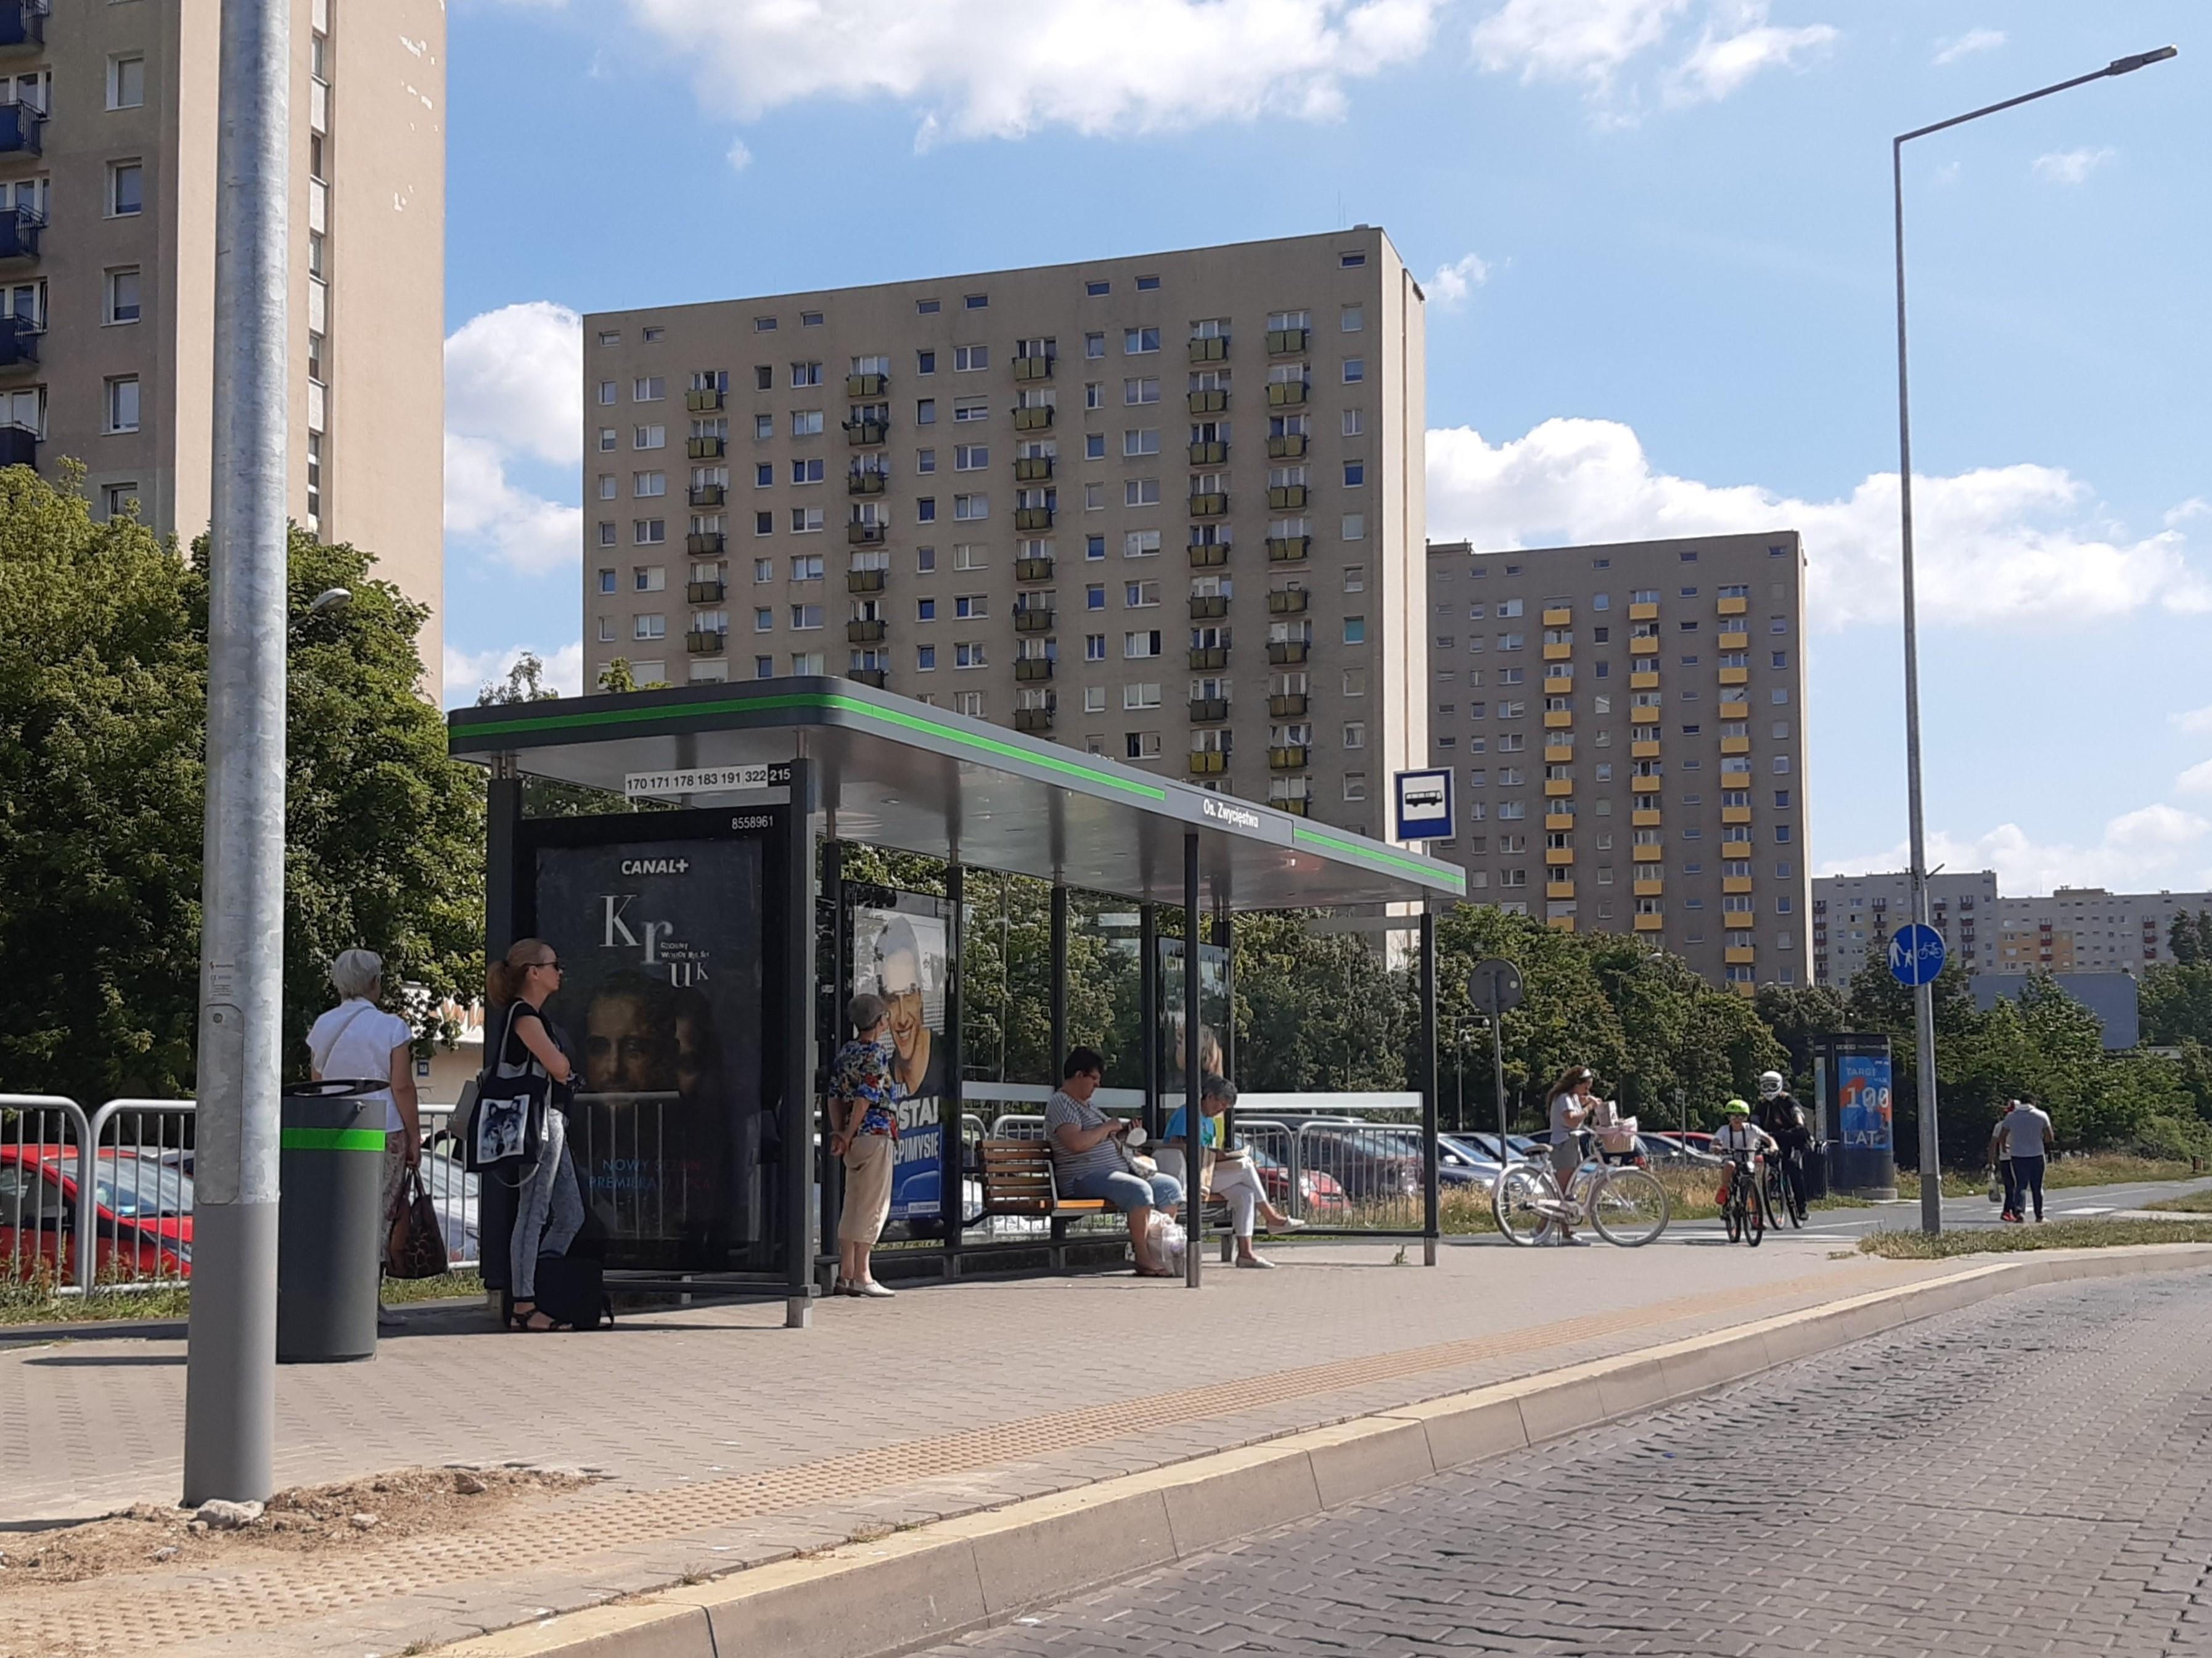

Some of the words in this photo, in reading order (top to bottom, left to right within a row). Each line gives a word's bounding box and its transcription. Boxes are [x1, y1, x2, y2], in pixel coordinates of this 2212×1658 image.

[627, 778, 647, 790] 170
[650, 776, 670, 789] 171
[674, 775, 694, 787] 178
[697, 773, 718, 785] 183
[721, 772, 740, 784] 191
[745, 770, 766, 782] 322
[769, 768, 791, 781] 215
[732, 815, 773, 830] 8558961
[1203, 798, 1216, 817] Os.
[1217, 802, 1259, 828] Zwycięstwa
[621, 859, 689, 875] CANAL+
[1846, 1067, 1876, 1077] TARGI
[1846, 1086, 1889, 1108] 100
[896, 1095, 940, 1130] STA!
[894, 1131, 940, 1165] EPIMYSIĘ
[1844, 1130, 1878, 1145] LAT
